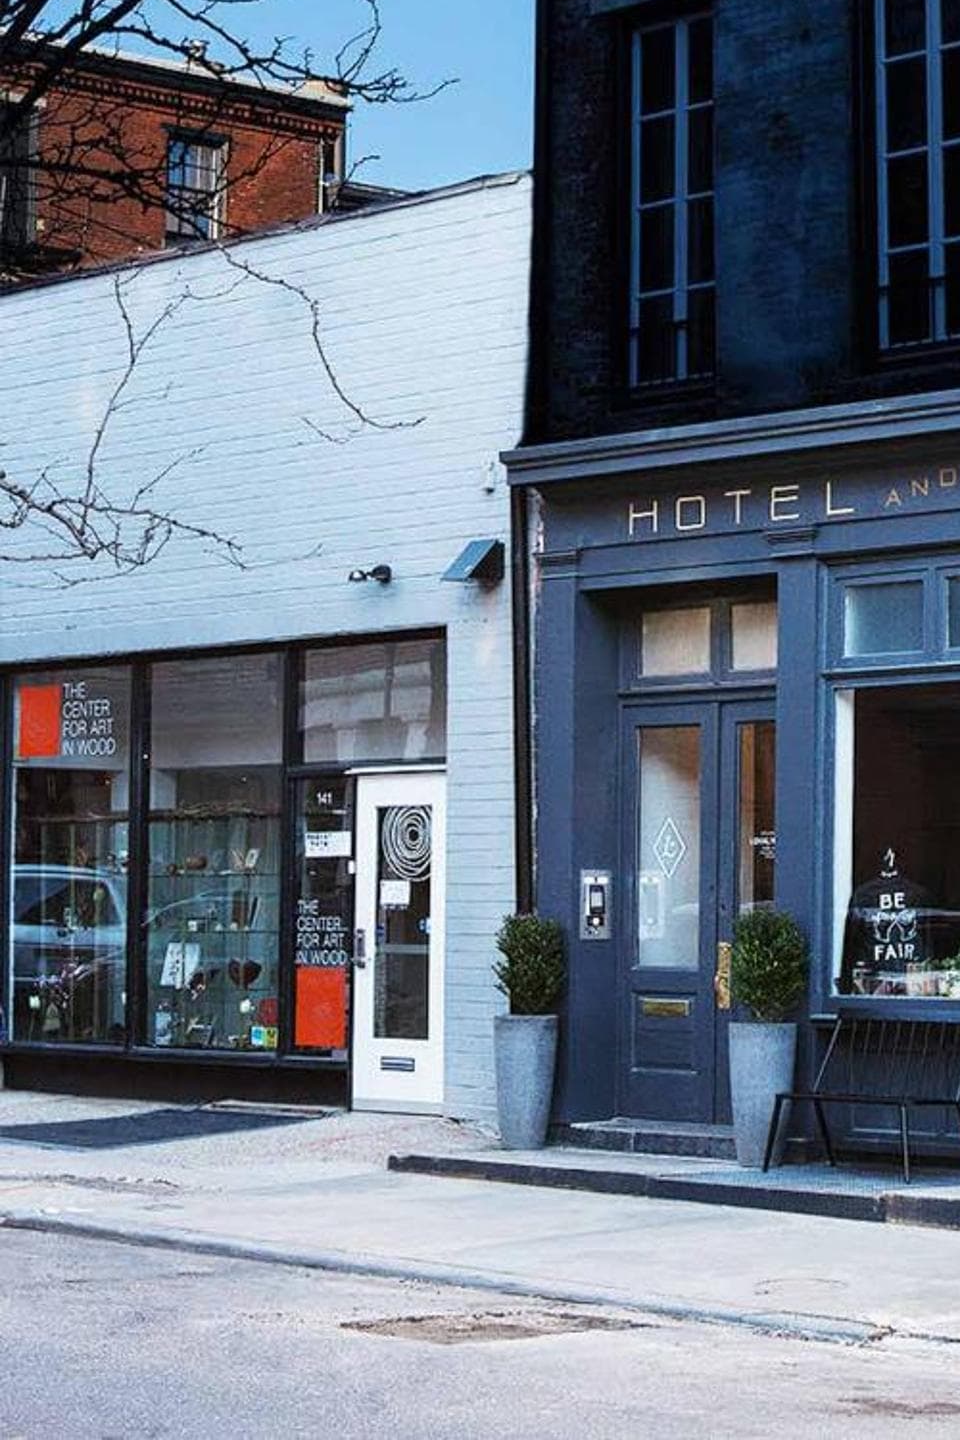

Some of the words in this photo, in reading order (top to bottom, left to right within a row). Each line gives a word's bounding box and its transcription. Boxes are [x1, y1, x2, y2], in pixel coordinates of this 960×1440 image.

[628, 480, 855, 536] HOTEL
[884, 466, 957, 508] AND
[63, 682, 86, 698] THE
[63, 699, 111, 719] CENTER
[63, 721, 87, 737] FOR
[90, 718, 114, 735] ART
[63, 740, 74, 757] IN
[78, 737, 116, 756] WOOD
[316, 791, 332, 805] 141
[296, 899, 319, 916] THE
[879, 892, 906, 910] BE
[296, 916, 342, 932] CENTER
[296, 933, 319, 948] FOR
[323, 933, 345, 948] ART
[296, 950, 308, 965] IN
[312, 949, 348, 965] WOOD
[874, 943, 916, 961] FAIR
